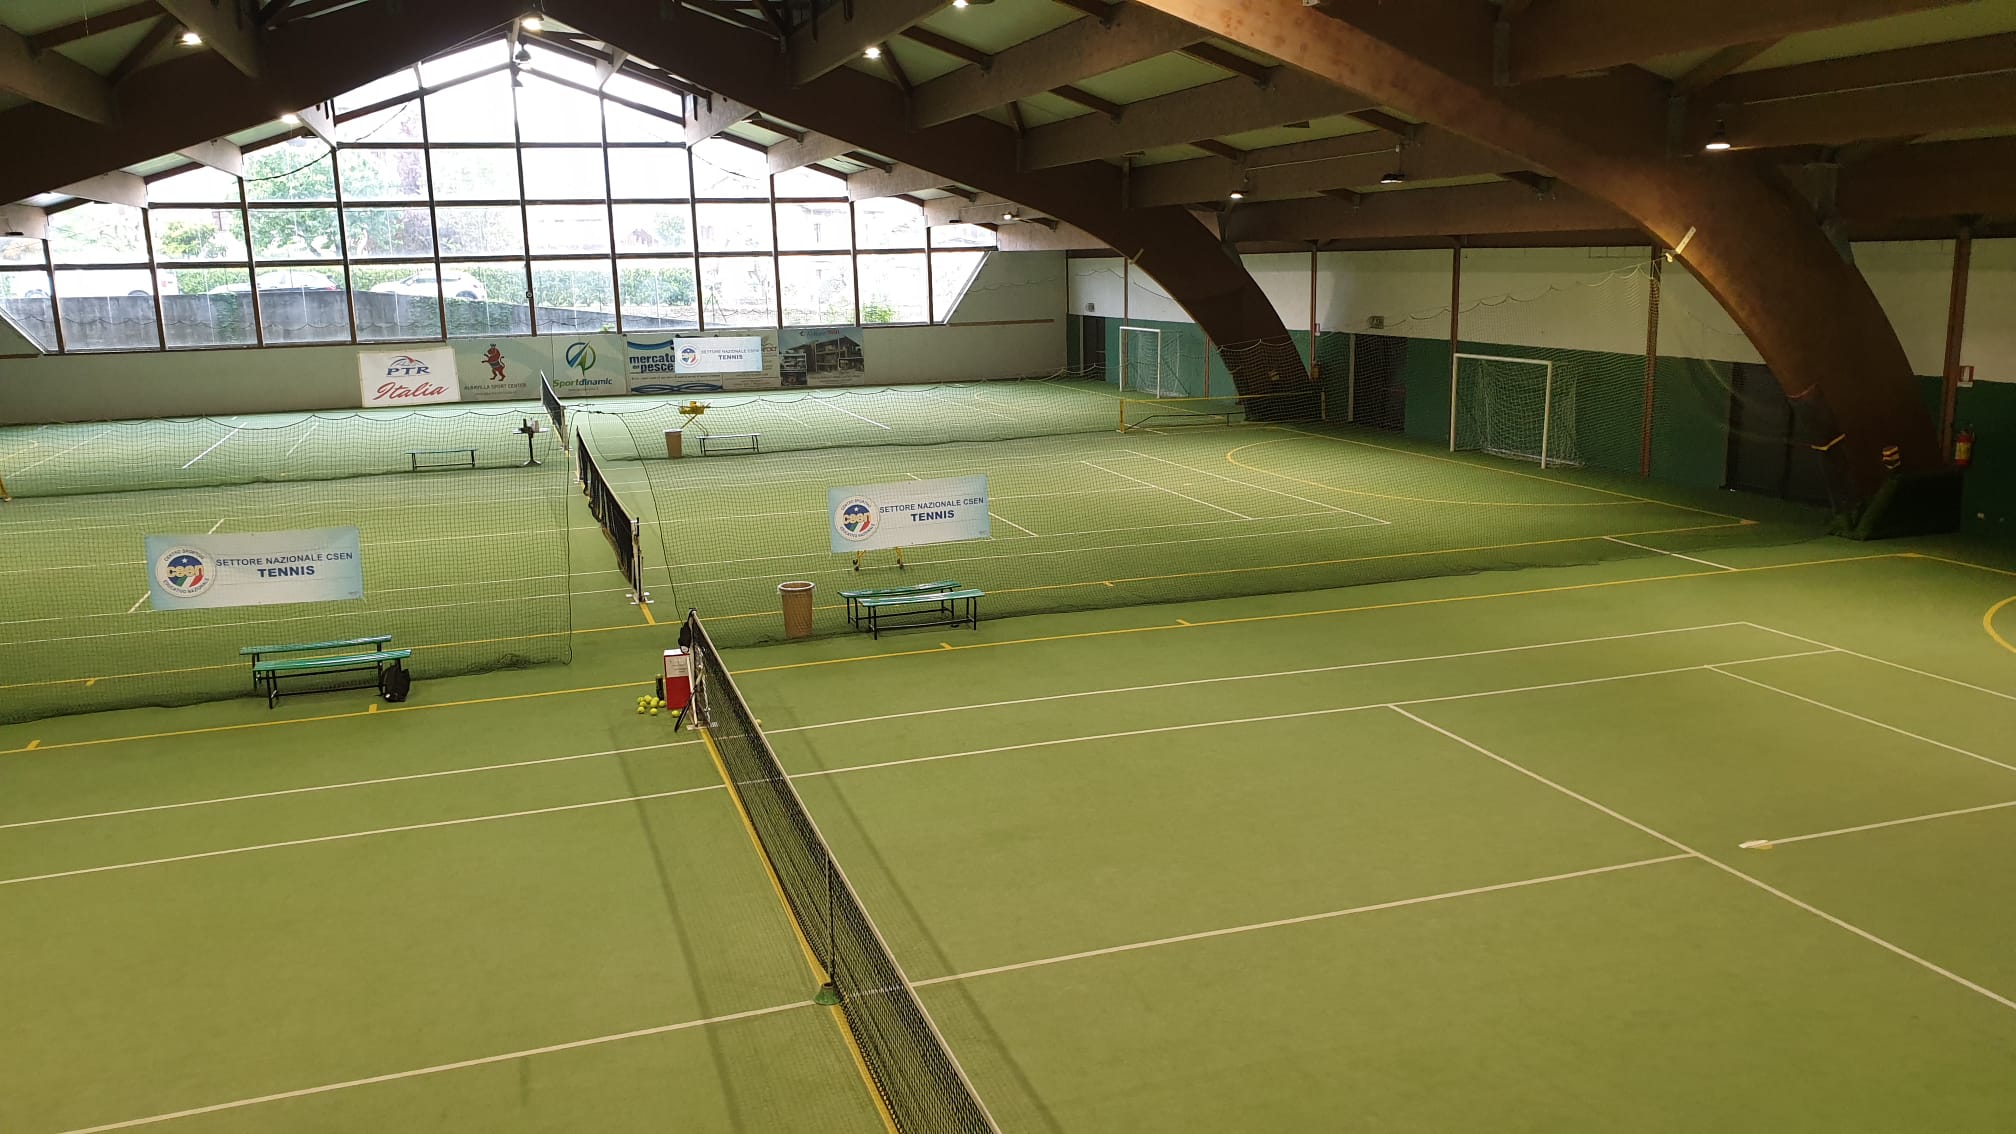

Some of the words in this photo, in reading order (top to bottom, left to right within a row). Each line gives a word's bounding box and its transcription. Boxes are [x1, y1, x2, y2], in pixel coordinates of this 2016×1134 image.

[629, 353, 676, 364] mercato
[386, 366, 430, 376] PTR
[640, 362, 674, 374] pesce
[372, 381, 449, 400] Italia
[879, 504, 915, 513] SETTORE
[917, 499, 962, 510] NAZIONALE
[963, 497, 984, 505] CSEN
[910, 509, 955, 522] TENNIS
[215, 556, 263, 567] SETTORE
[265, 553, 324, 565] NAZIONALE
[325, 551, 354, 562] CSEN
[256, 564, 316, 578] TENNIS
